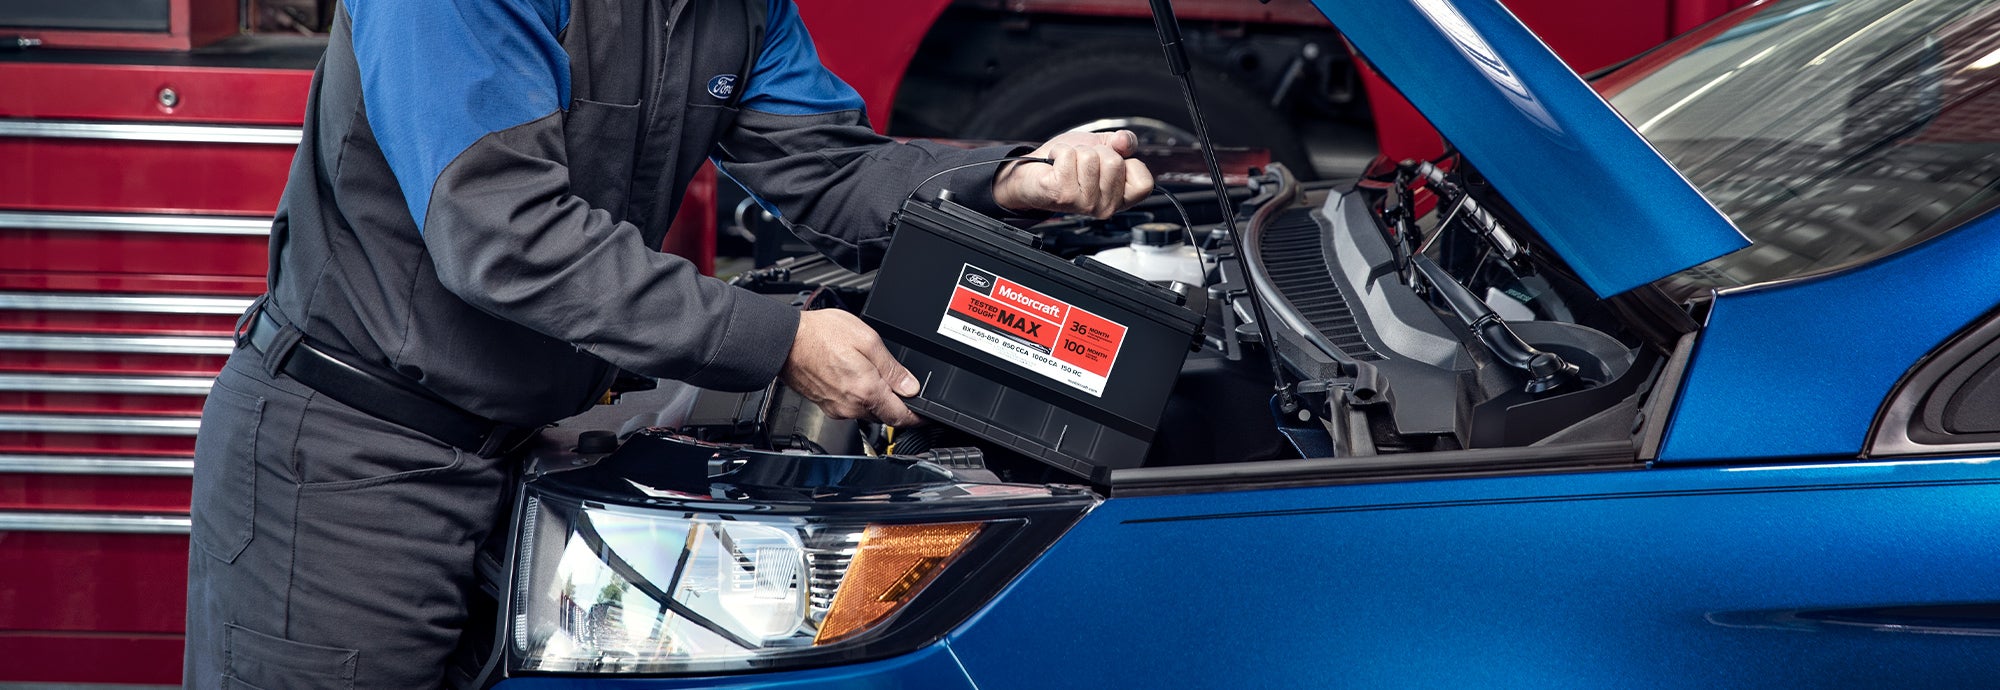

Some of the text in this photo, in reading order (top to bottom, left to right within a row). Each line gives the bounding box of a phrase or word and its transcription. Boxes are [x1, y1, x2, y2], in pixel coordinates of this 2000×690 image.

[713, 76, 735, 95] For
[970, 298, 998, 313] TESTED
[998, 285, 1060, 318] Motorcraft
[996, 309, 1043, 337] MAX
[1070, 321, 1087, 335] 36
[1088, 327, 1110, 339] MONTH
[962, 325, 1000, 344] BXT-65-850
[1002, 341, 1015, 350] 850
[1015, 346, 1029, 356] CCA
[1032, 352, 1048, 364] 1000
[1048, 358, 1058, 368] CA
[1060, 364, 1072, 373] 150
[1072, 369, 1083, 377] RC
[1063, 338, 1086, 355] 100
[1086, 347, 1108, 359] MONTH
